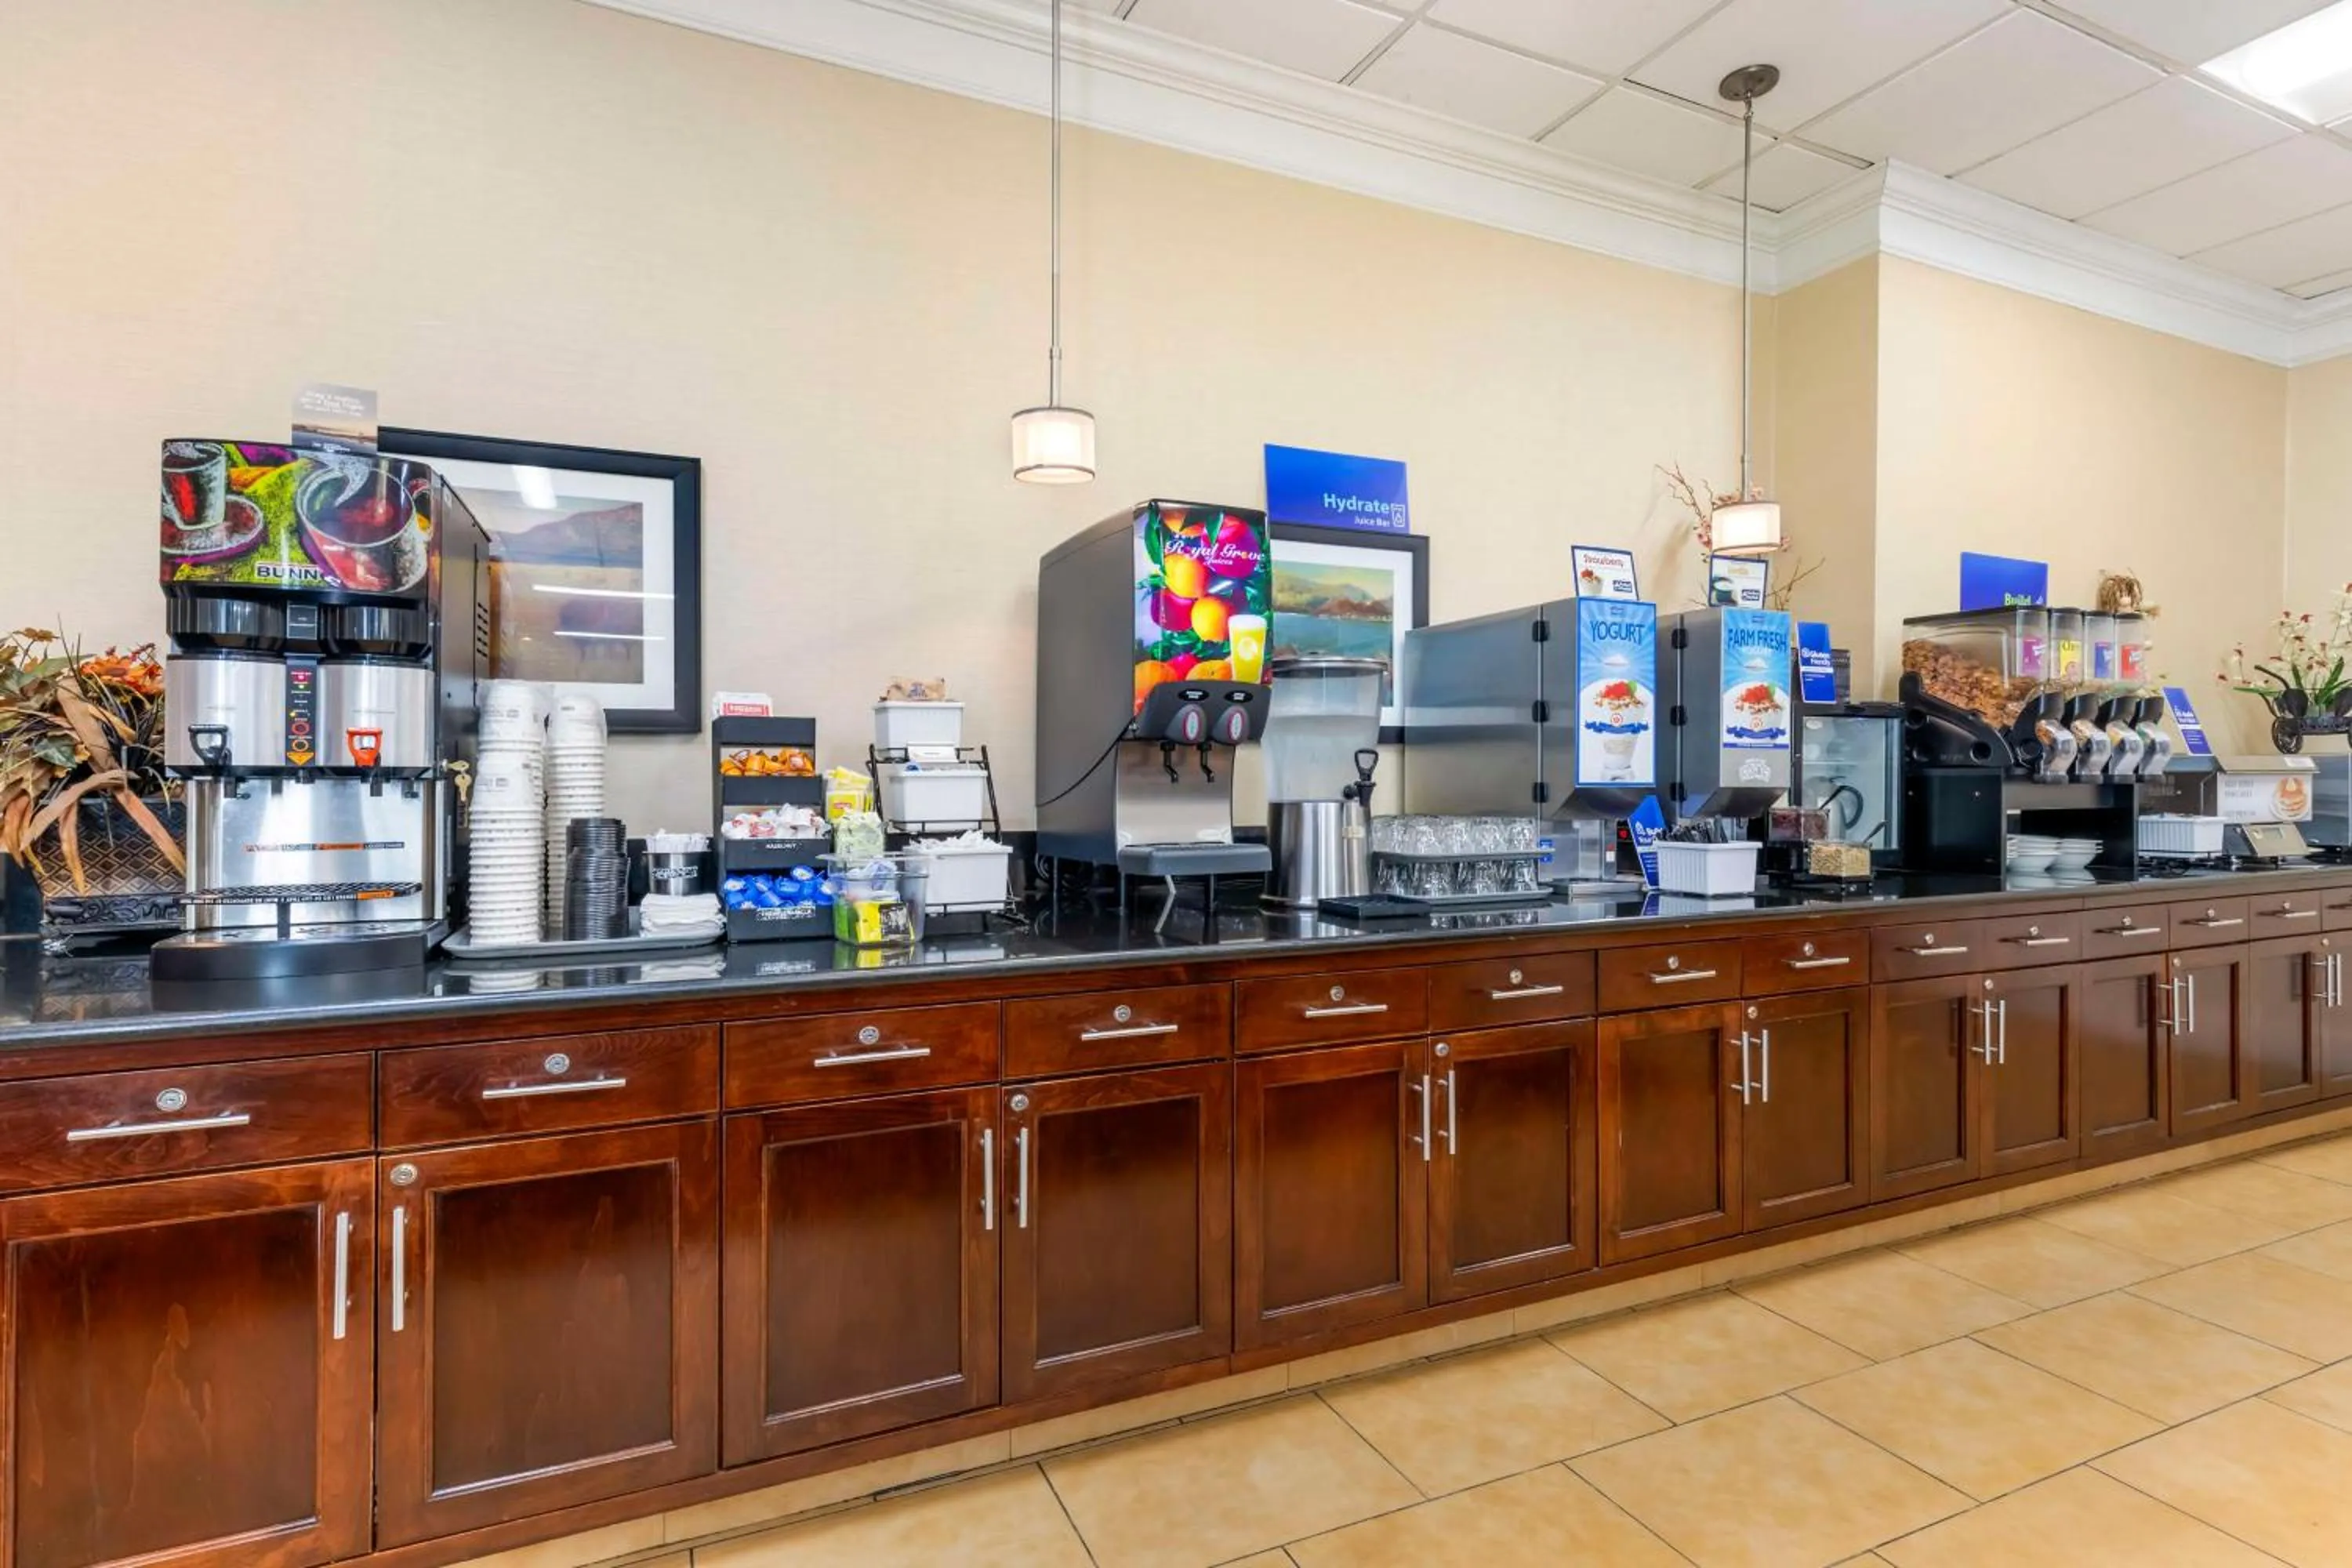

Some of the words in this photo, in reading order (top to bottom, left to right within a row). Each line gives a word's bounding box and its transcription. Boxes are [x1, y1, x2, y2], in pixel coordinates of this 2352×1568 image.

[1323, 492, 1390, 514] Hydrate
[1354, 515, 1374, 526] Juice
[1376, 517, 1391, 528] Bar
[1220, 543, 1265, 560] Grove
[256, 565, 318, 579] BUNN
[1590, 620, 1646, 646] YOGURT
[1726, 628, 1755, 650] FARM
[1757, 630, 1788, 653] FRESH
